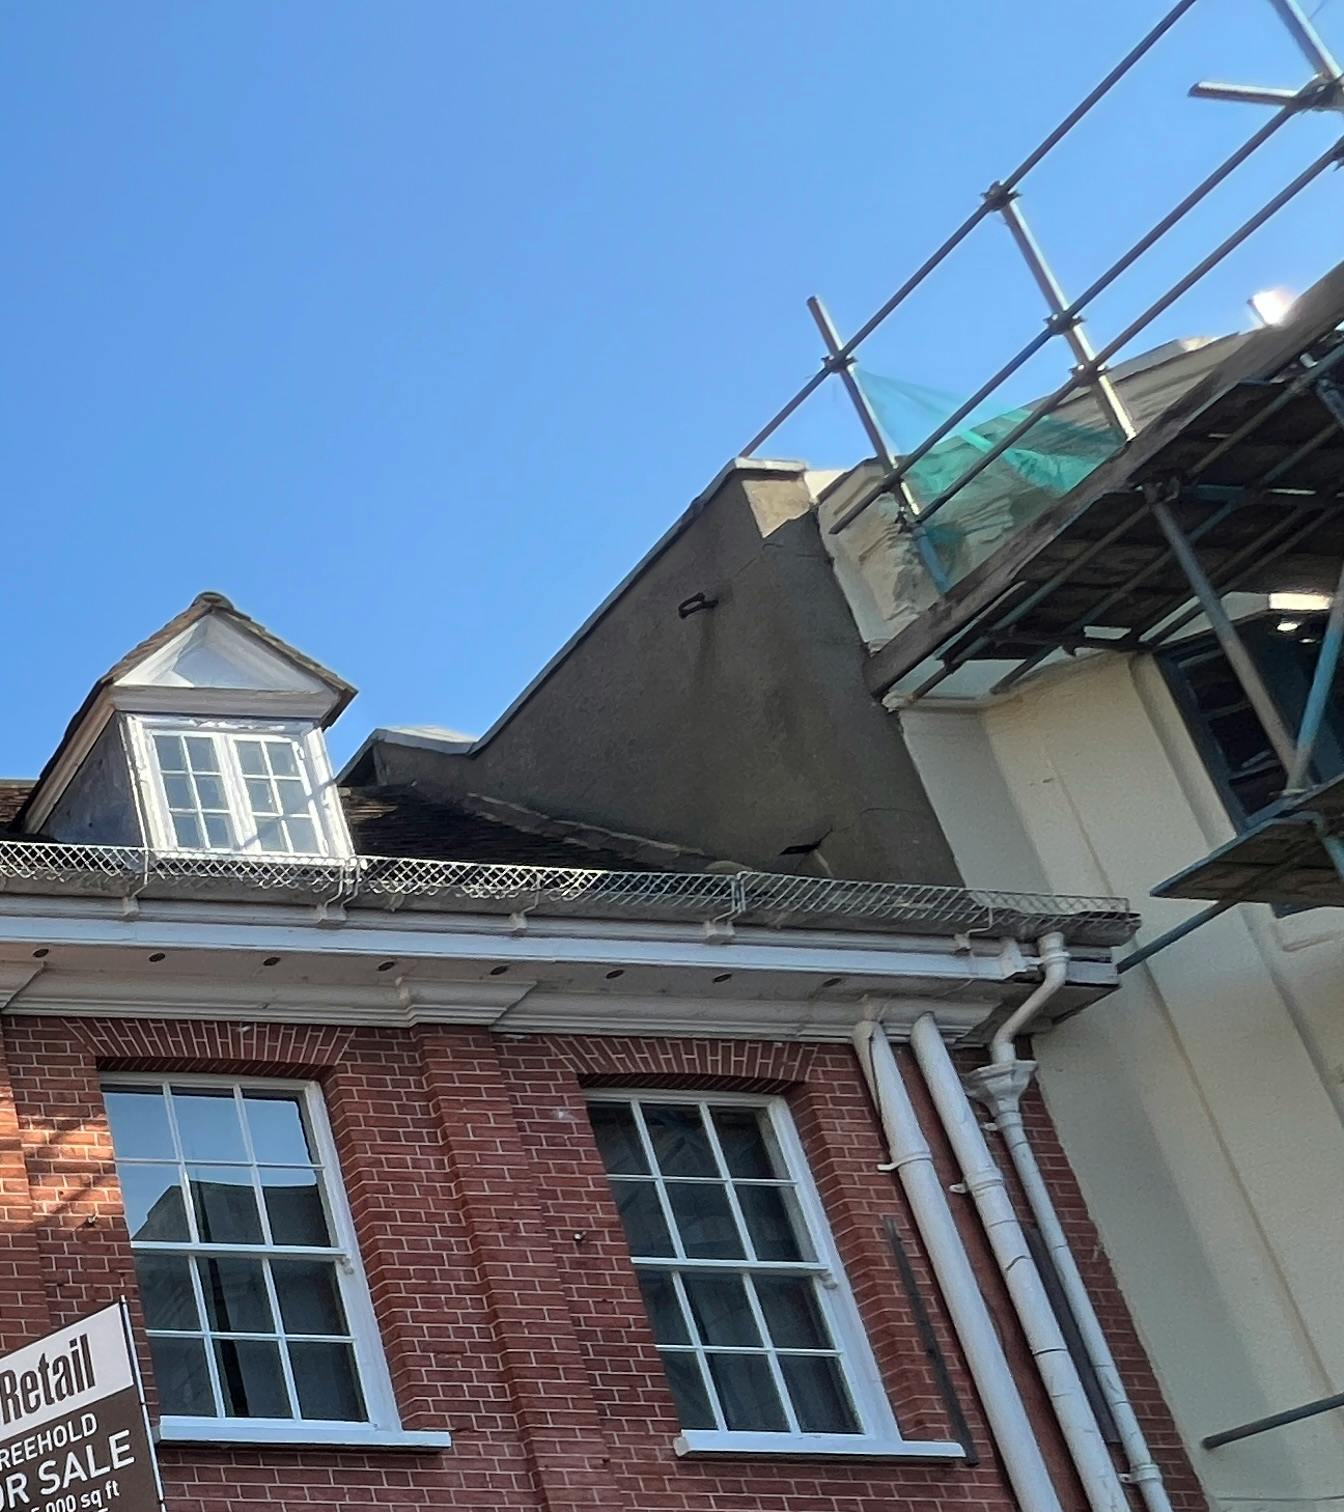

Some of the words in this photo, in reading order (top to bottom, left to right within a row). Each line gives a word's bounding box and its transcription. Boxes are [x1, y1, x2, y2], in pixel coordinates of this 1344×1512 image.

[38, 1429, 135, 1495] SALE
[80, 1490, 102, 1509] sq
[104, 1480, 120, 1499] ft
